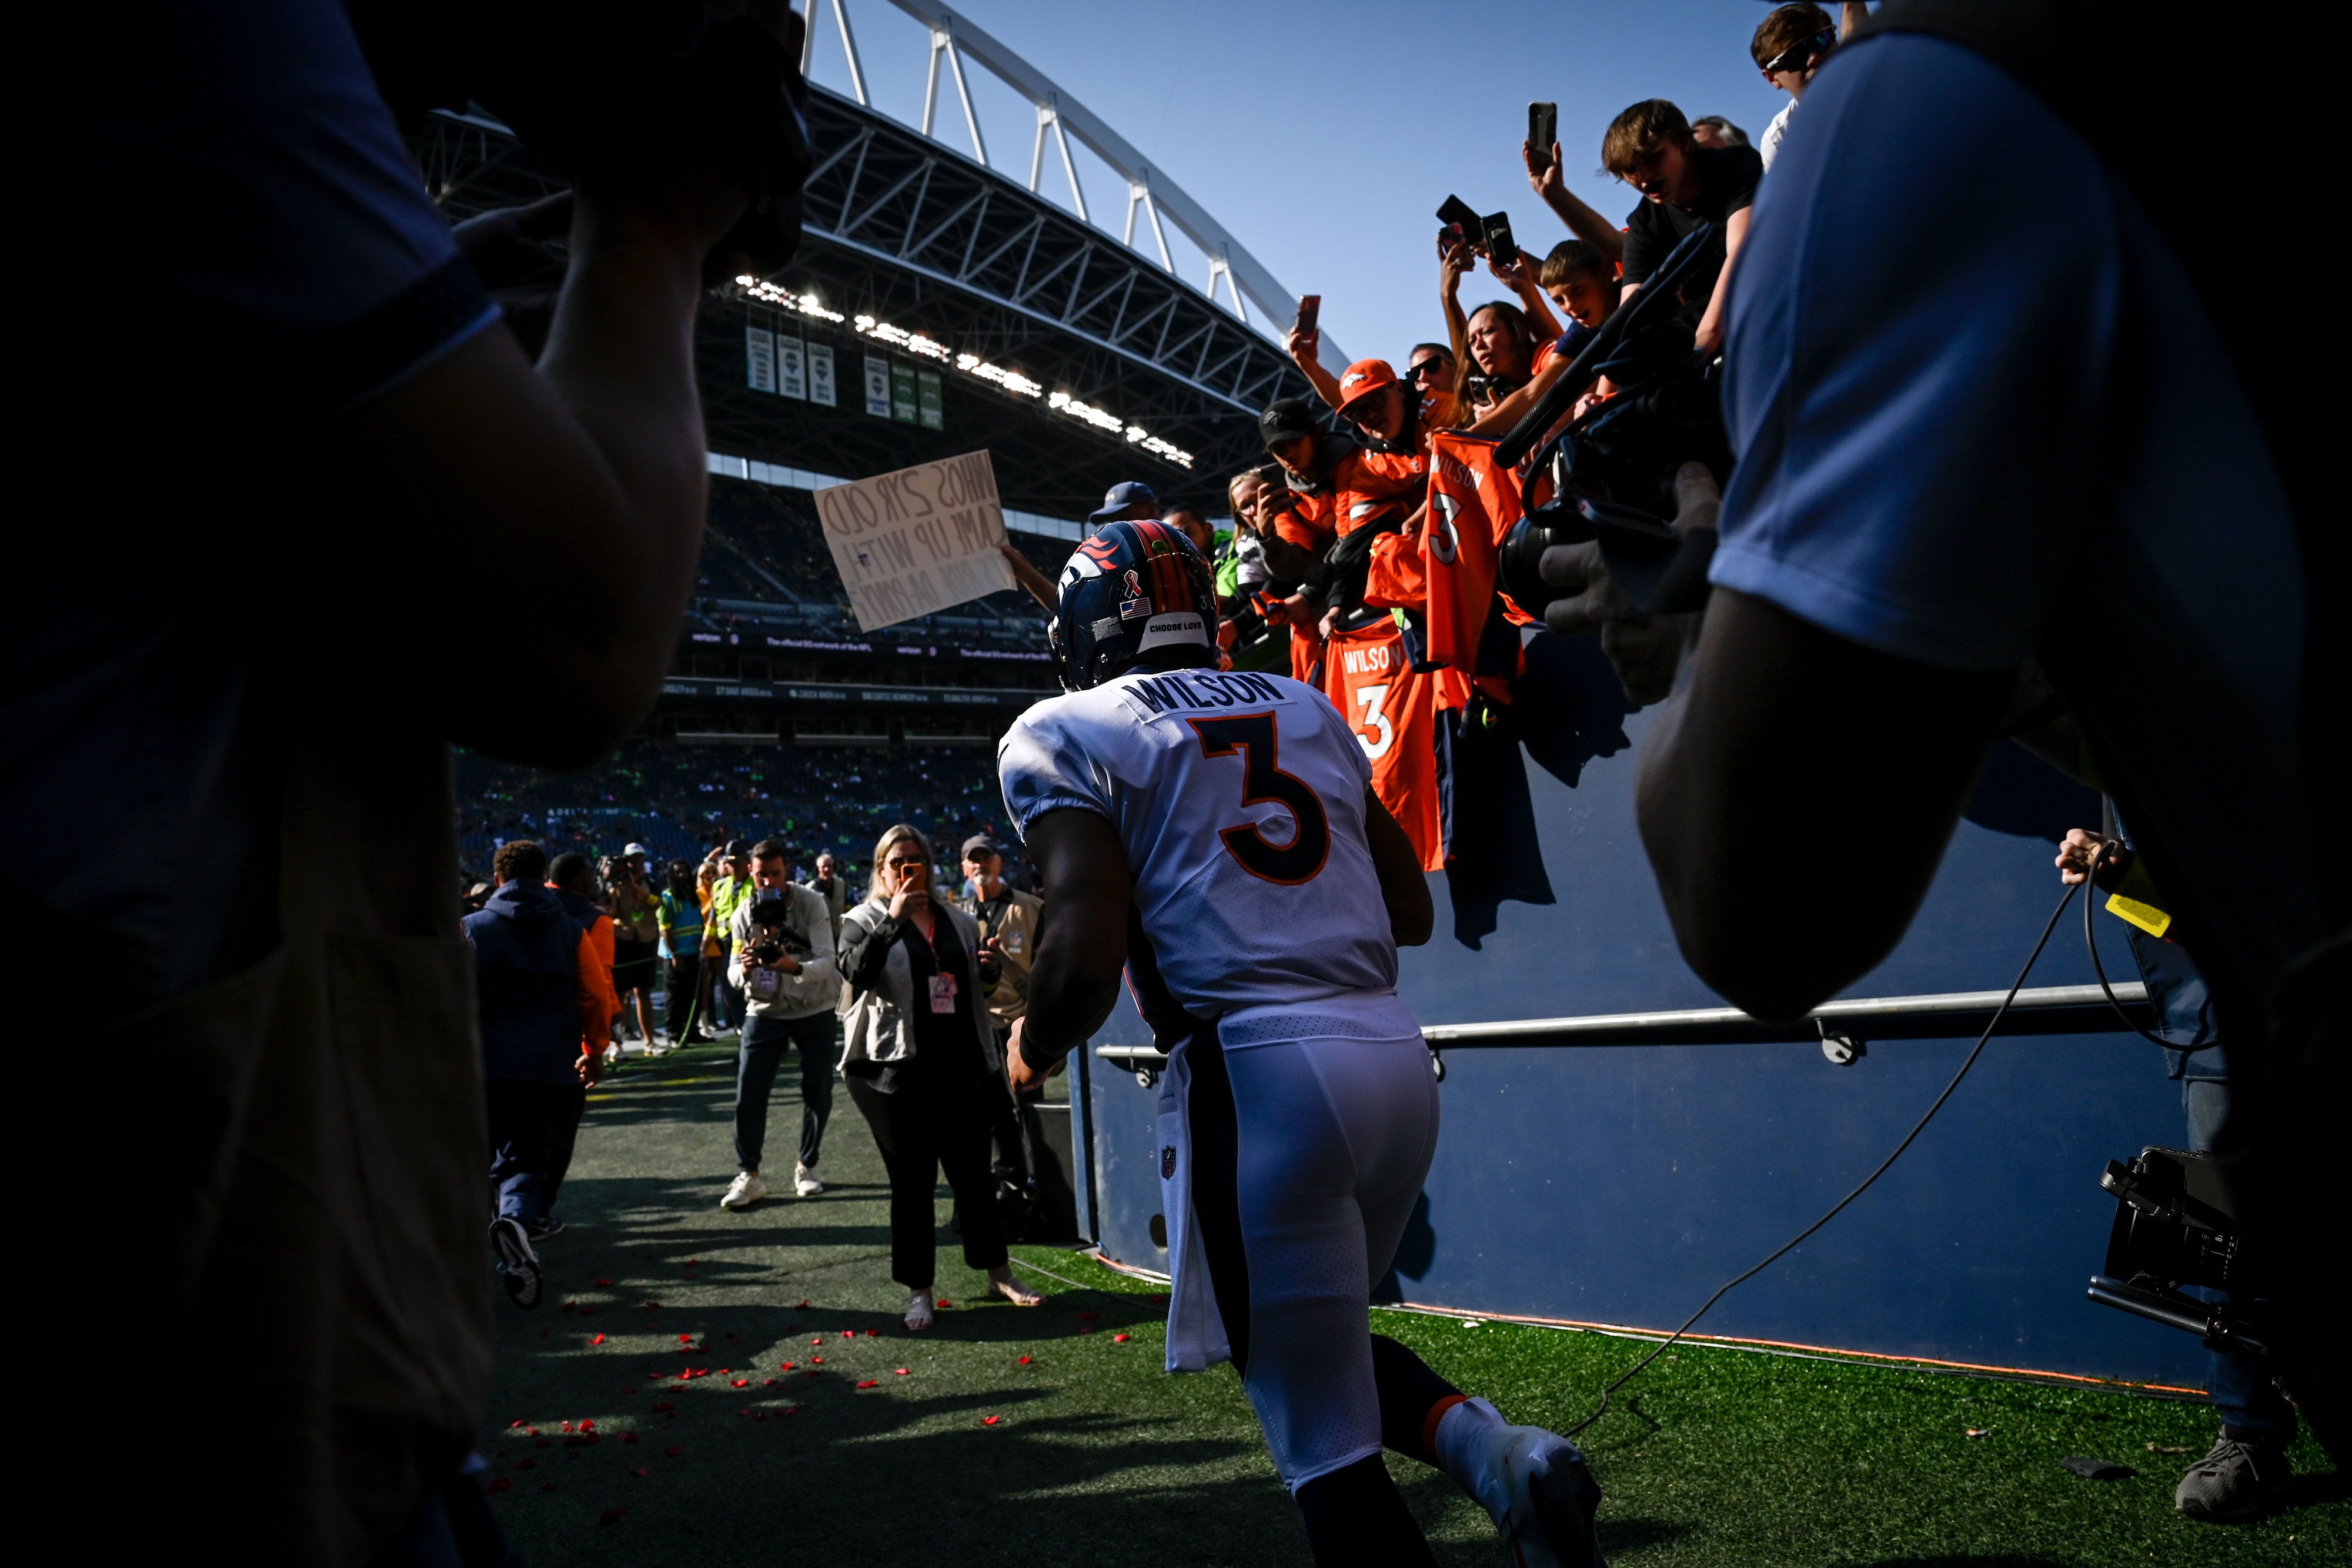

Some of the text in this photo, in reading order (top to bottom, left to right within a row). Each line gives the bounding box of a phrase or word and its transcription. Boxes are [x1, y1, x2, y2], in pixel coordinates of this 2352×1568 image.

[1430, 453, 1484, 490] WILSON
[1429, 493, 1462, 564] 3
[1200, 595, 1208, 610] 3
[1150, 621, 1202, 633] CHOOSE LOVE
[1343, 645, 1402, 674] WILSON
[1121, 673, 1285, 714] WILSON
[1355, 684, 1394, 760] 3
[1185, 710, 1331, 885] 3
